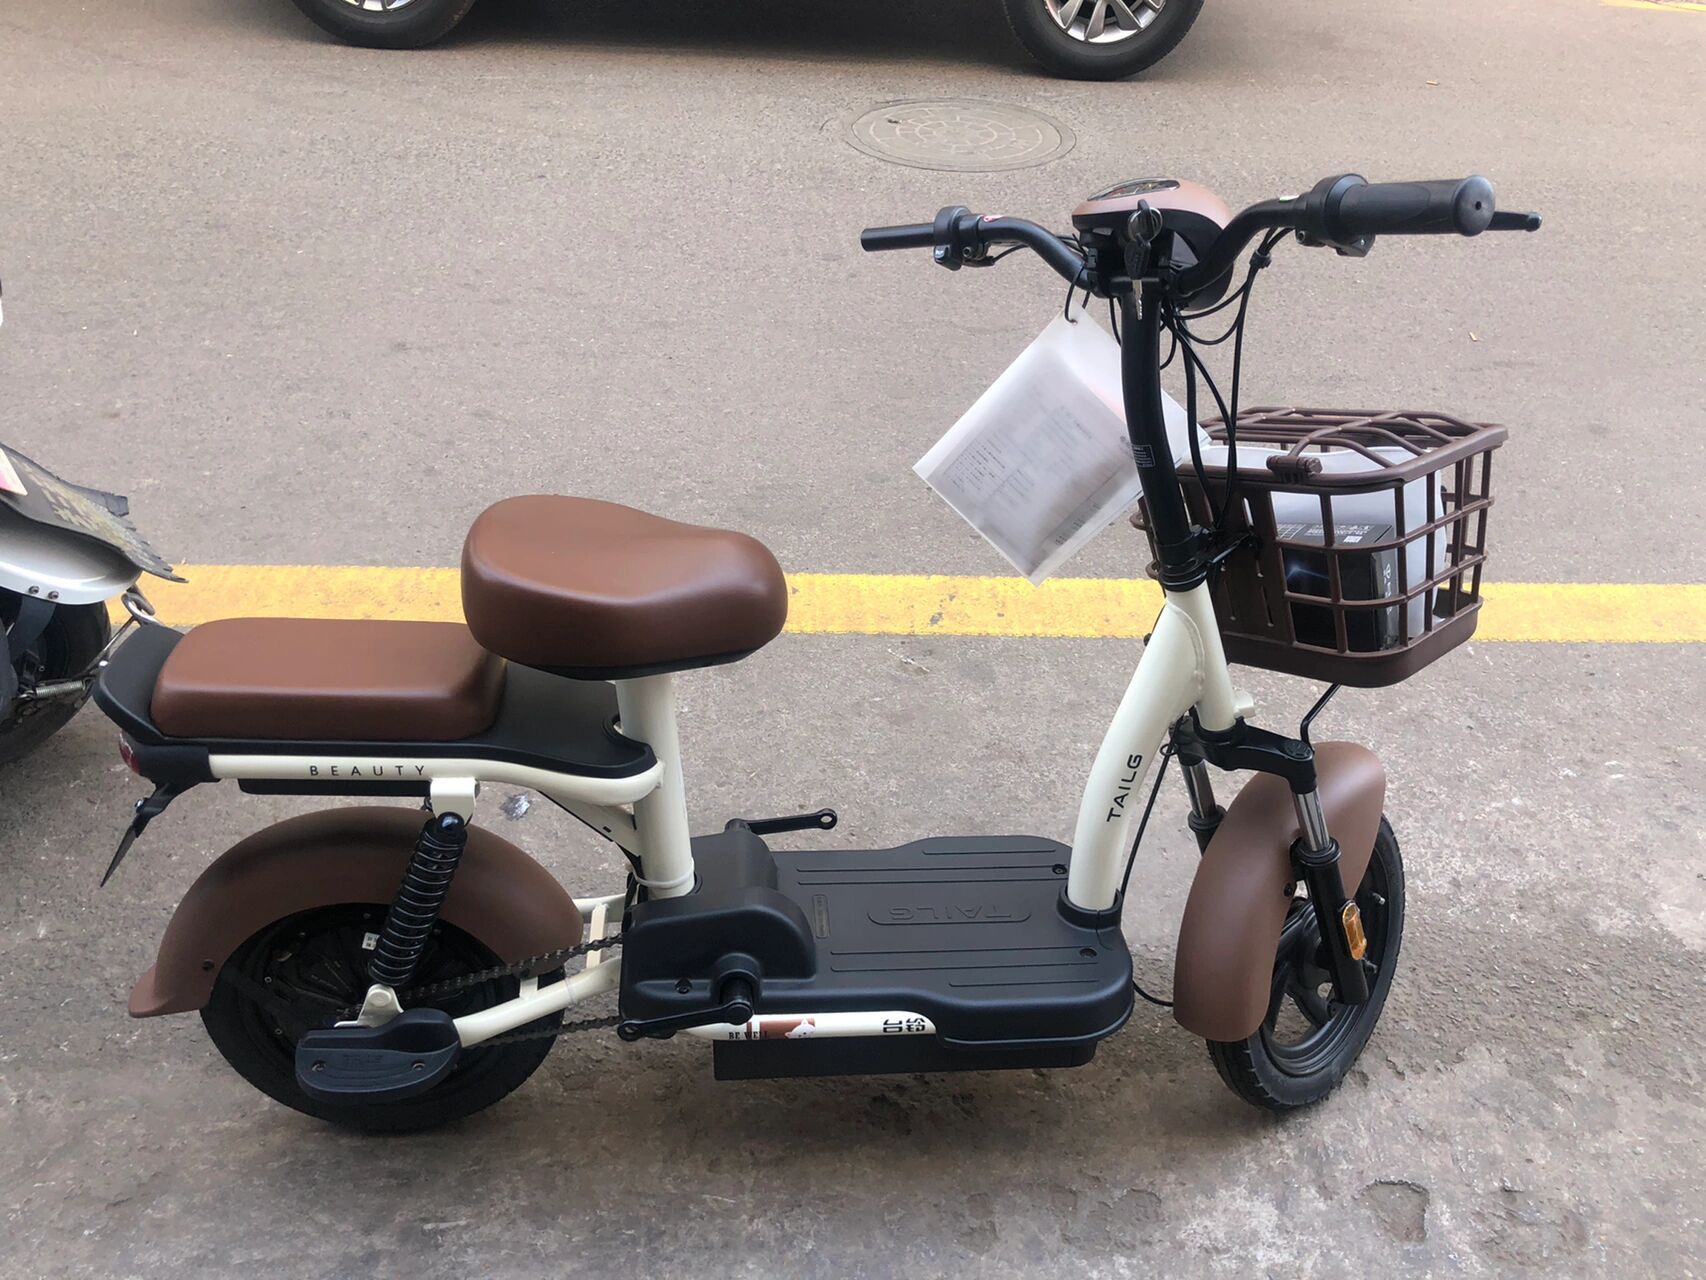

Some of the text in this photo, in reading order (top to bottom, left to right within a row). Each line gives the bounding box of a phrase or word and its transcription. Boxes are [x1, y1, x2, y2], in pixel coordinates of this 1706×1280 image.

[310, 765, 424, 776] BEAUTY
[1106, 754, 1142, 822] TAILG
[889, 905, 1011, 920] TAILG
[883, 1018, 925, 1033] 台铃
